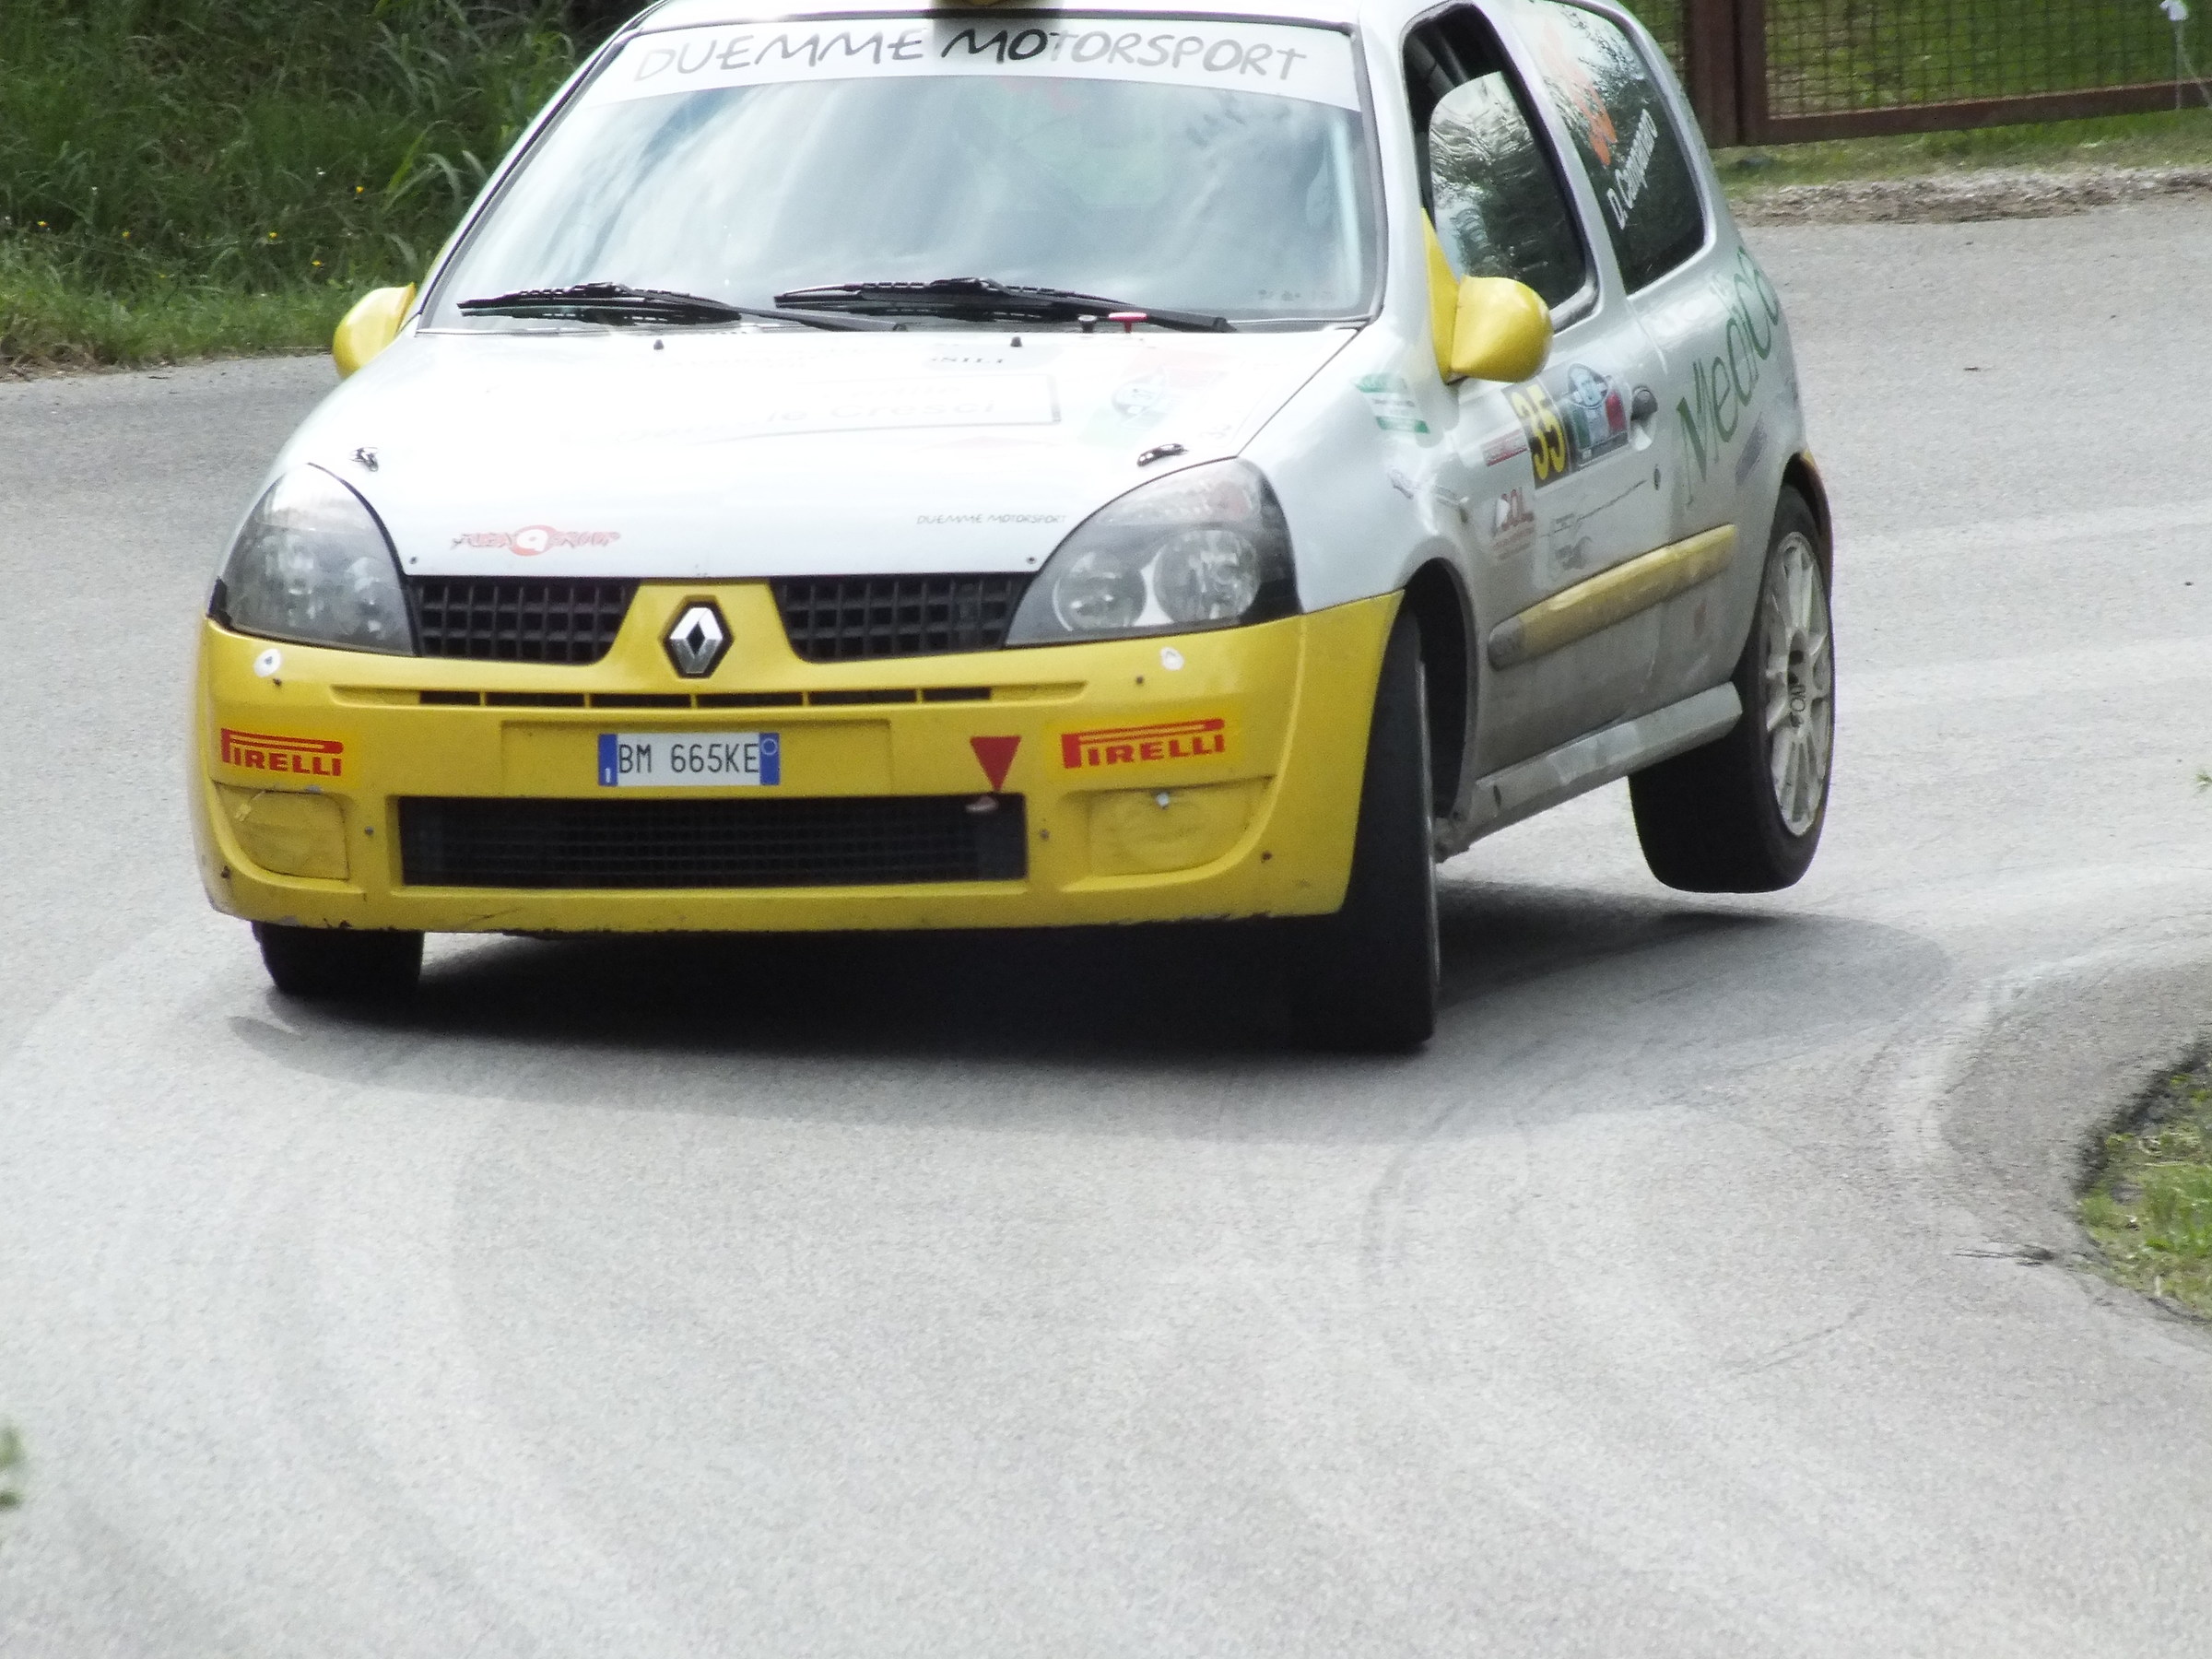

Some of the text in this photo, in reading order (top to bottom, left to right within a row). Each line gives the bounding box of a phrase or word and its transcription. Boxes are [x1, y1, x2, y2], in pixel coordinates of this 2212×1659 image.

[633, 29, 1307, 81] DUEMME MOTORSPORT
[1511, 383, 1567, 480] 35
[916, 513, 1066, 525] DUEMME MOTORSPORT
[220, 728, 344, 776] PIRELLI
[618, 743, 653, 773] BM
[670, 743, 759, 773] 665KE
[1061, 718, 1225, 769] PIRELLI
